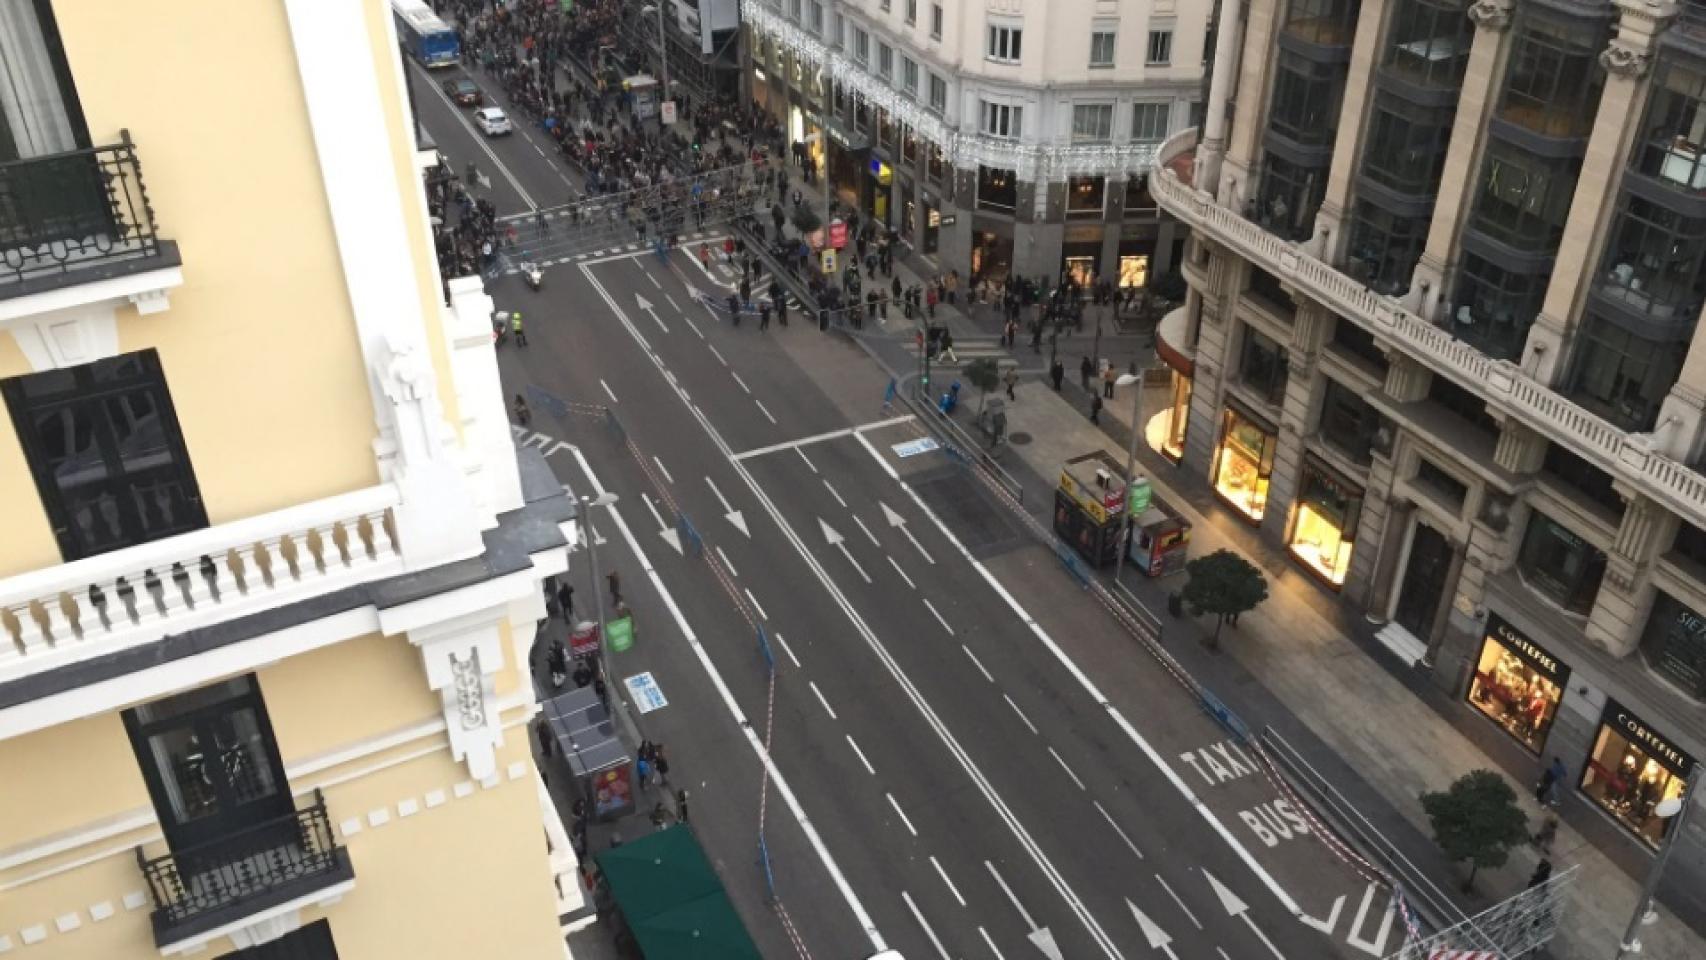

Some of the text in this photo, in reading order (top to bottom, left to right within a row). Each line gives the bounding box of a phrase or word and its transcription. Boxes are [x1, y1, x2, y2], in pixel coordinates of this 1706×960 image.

[1498, 626, 1556, 673] CORTEFIEL
[1179, 739, 1259, 786] TAXI
[1618, 713, 1684, 768] CORTEFIEL
[1238, 799, 1310, 848] BUS
